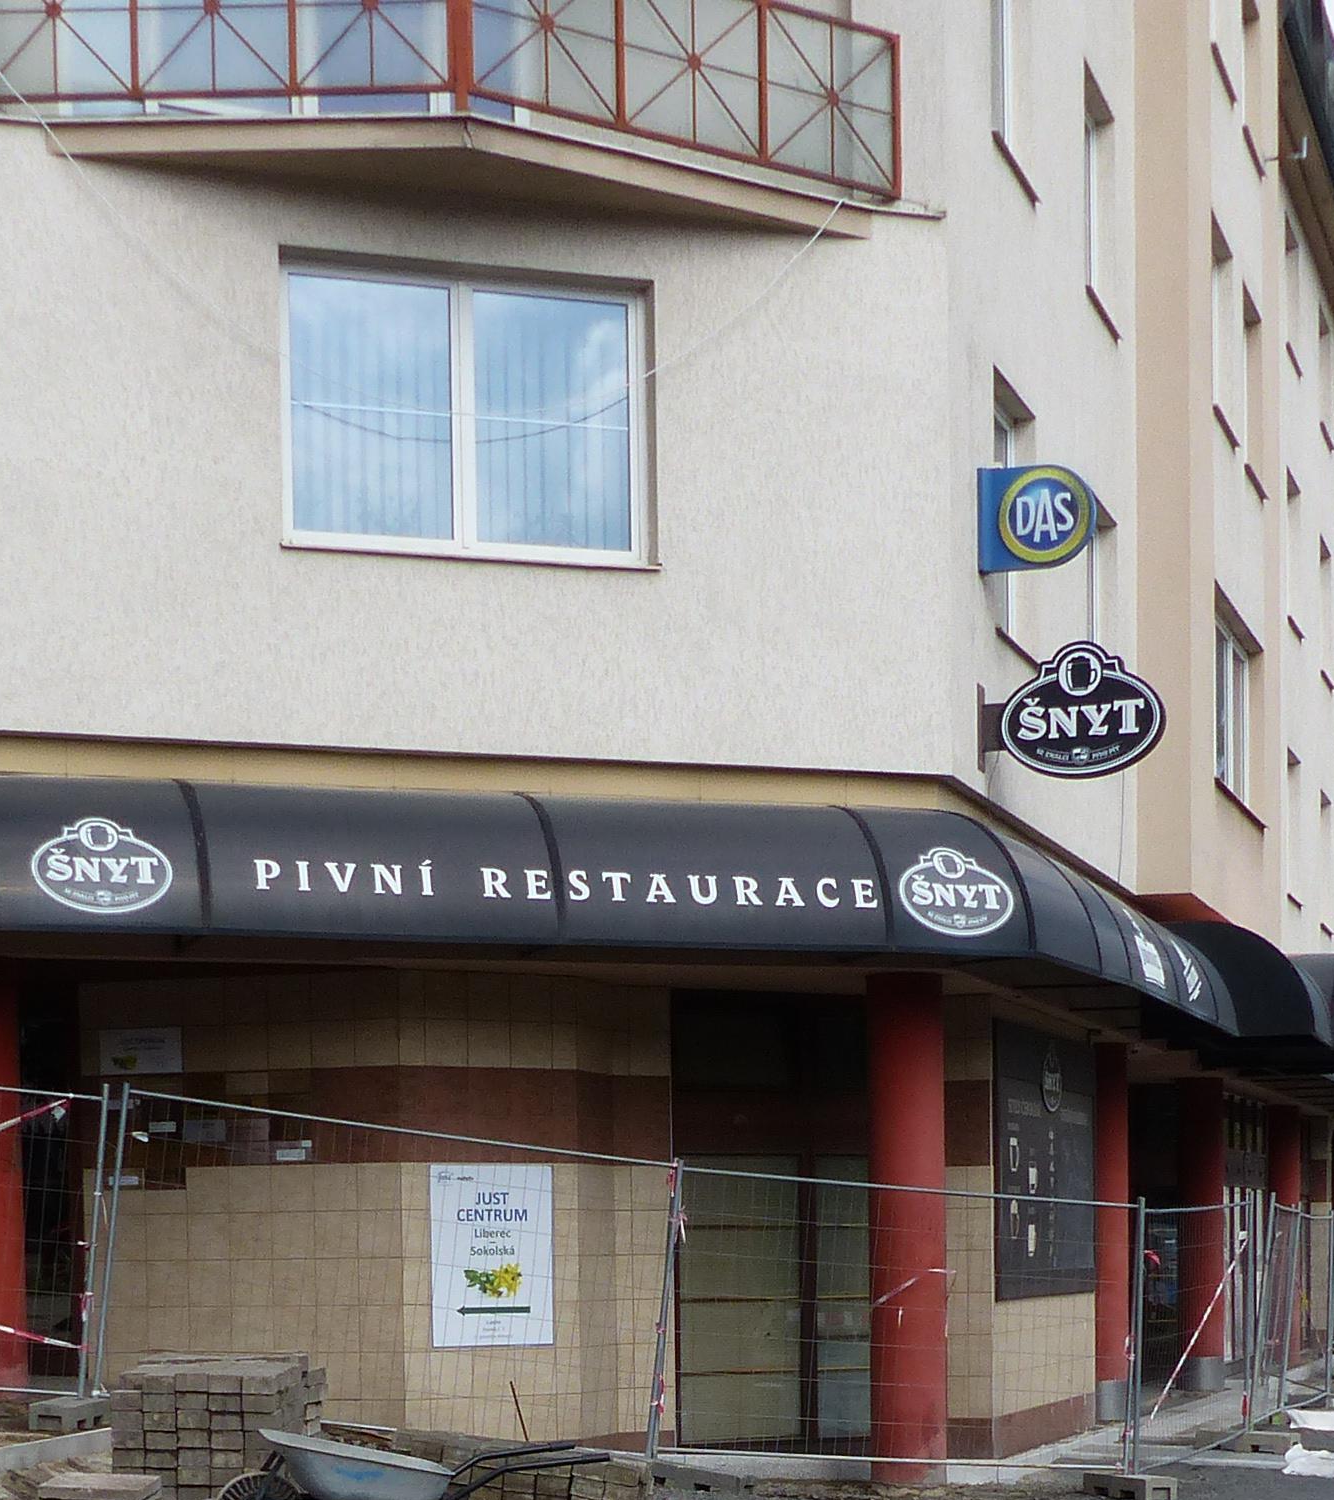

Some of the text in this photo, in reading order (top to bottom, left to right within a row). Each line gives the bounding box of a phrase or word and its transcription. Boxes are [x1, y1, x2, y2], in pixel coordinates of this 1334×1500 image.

[1016, 488, 1074, 543] DAS
[1017, 697, 1145, 740] ŠNYT
[46, 848, 159, 884] ŠNYT
[253, 858, 879, 908] PIVNÍ RESTAURACE
[911, 874, 1001, 909] ŠNYT
[457, 1208, 528, 1222] CENTRUM
[475, 1192, 509, 1206] JUST
[469, 1245, 515, 1256] Sokolská
[474, 1228, 511, 1239] Liberec
